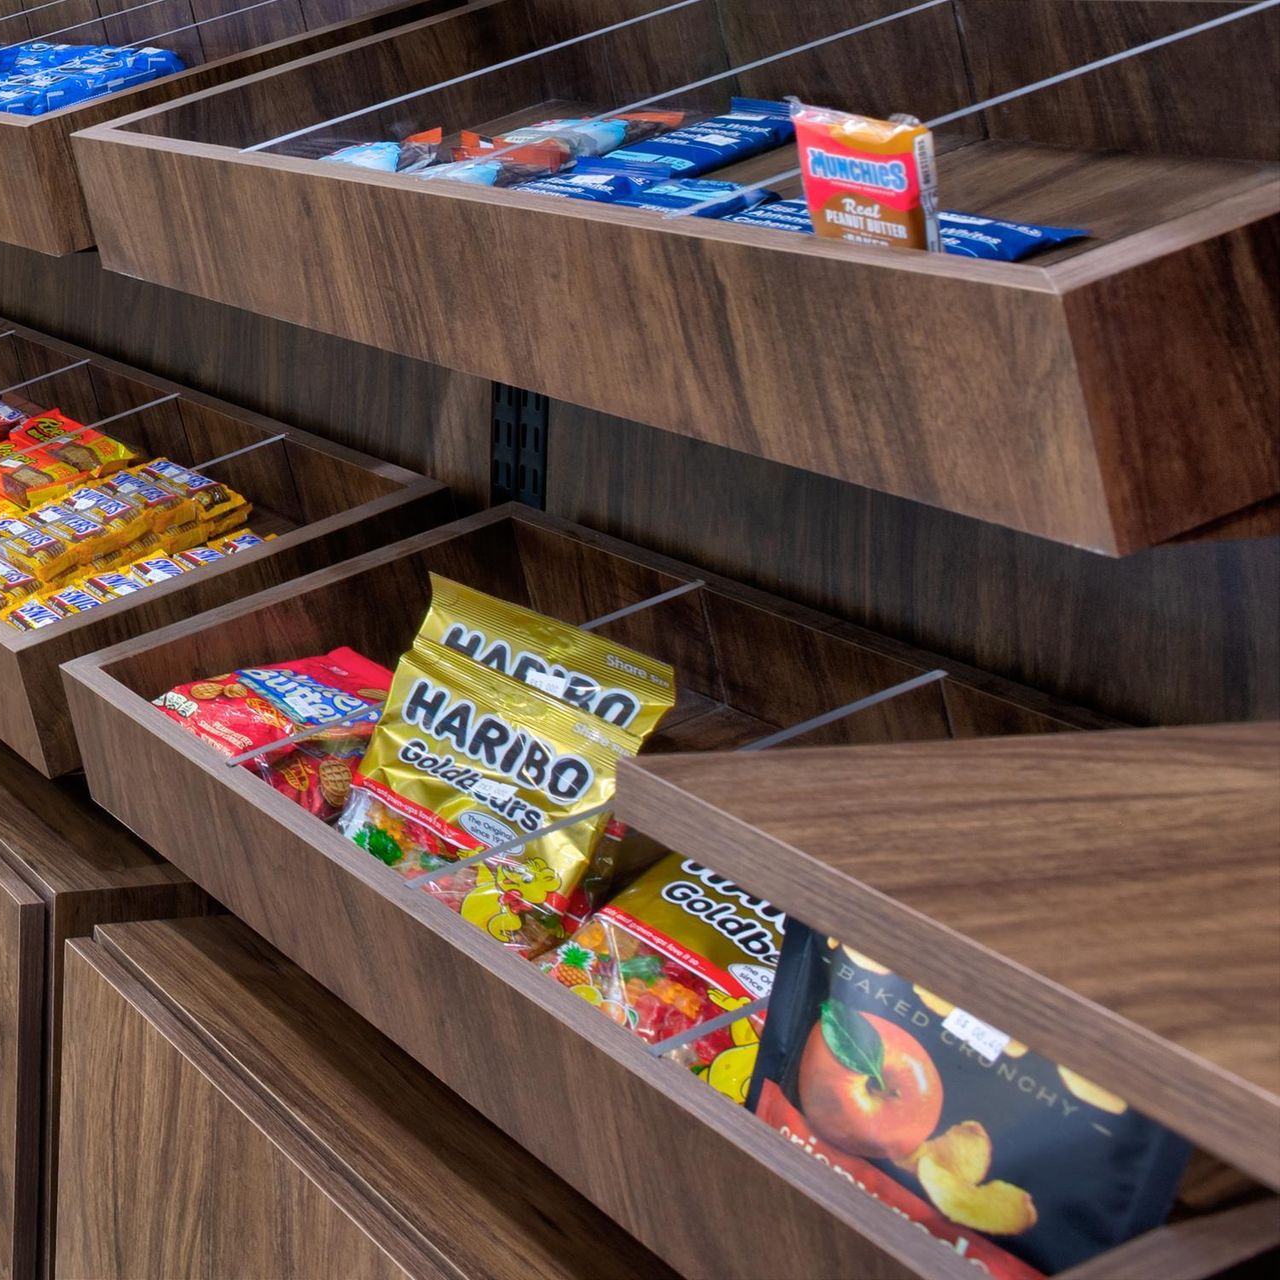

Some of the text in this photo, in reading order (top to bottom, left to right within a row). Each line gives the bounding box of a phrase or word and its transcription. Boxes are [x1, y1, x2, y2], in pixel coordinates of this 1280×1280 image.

[825, 208, 908, 239] PEANUT BUTTER
[841, 197, 881, 219] Real
[606, 654, 670, 688] Share size
[404, 681, 590, 801] HARIBO
[468, 814, 513, 840] The Original
[471, 824, 489, 839] since
[629, 919, 667, 947] grown-ups
[666, 943, 683, 957] love
[682, 952, 690, 962] it
[740, 972, 764, 992] since
[836, 964, 930, 1029] BAKED
[939, 1029, 1081, 1118] CRUNCHY
